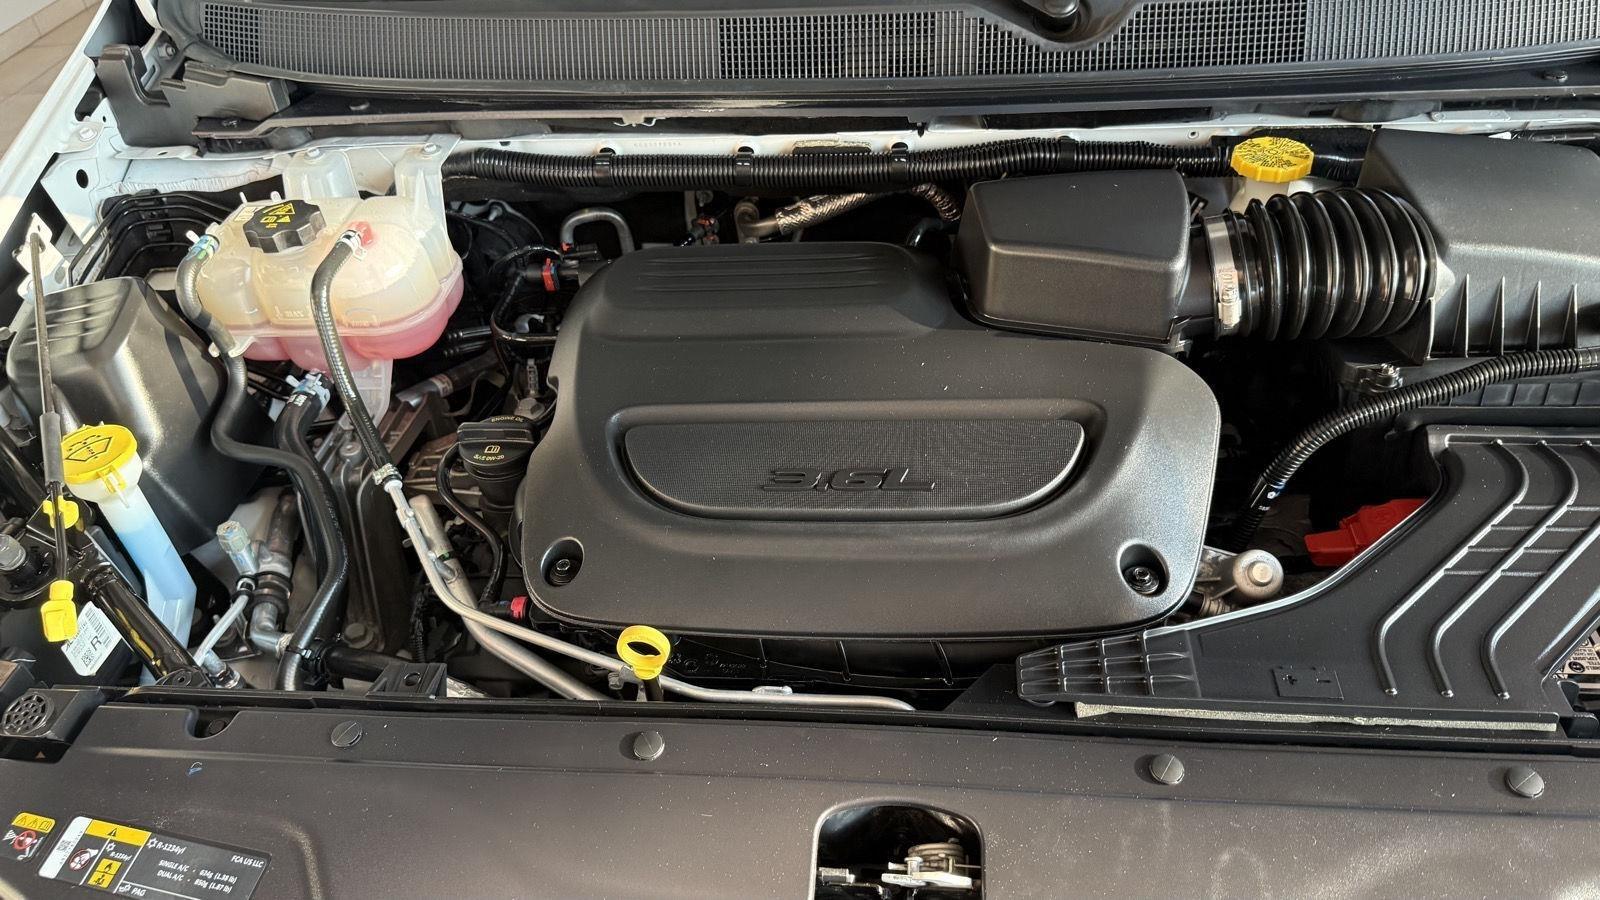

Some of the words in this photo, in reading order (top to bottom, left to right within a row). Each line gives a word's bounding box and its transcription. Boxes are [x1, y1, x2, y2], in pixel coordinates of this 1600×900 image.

[761, 468, 935, 492] 3.6L
[156, 841, 187, 855] R-1234yf
[158, 859, 179, 870] SINGLE
[176, 863, 190, 872] A/C
[231, 855, 244, 864] FCA
[243, 858, 254, 866] US
[252, 859, 265, 868] LLC
[157, 869, 173, 879] DUAL
[171, 873, 185, 882] A/C
[131, 887, 147, 897] PAG
